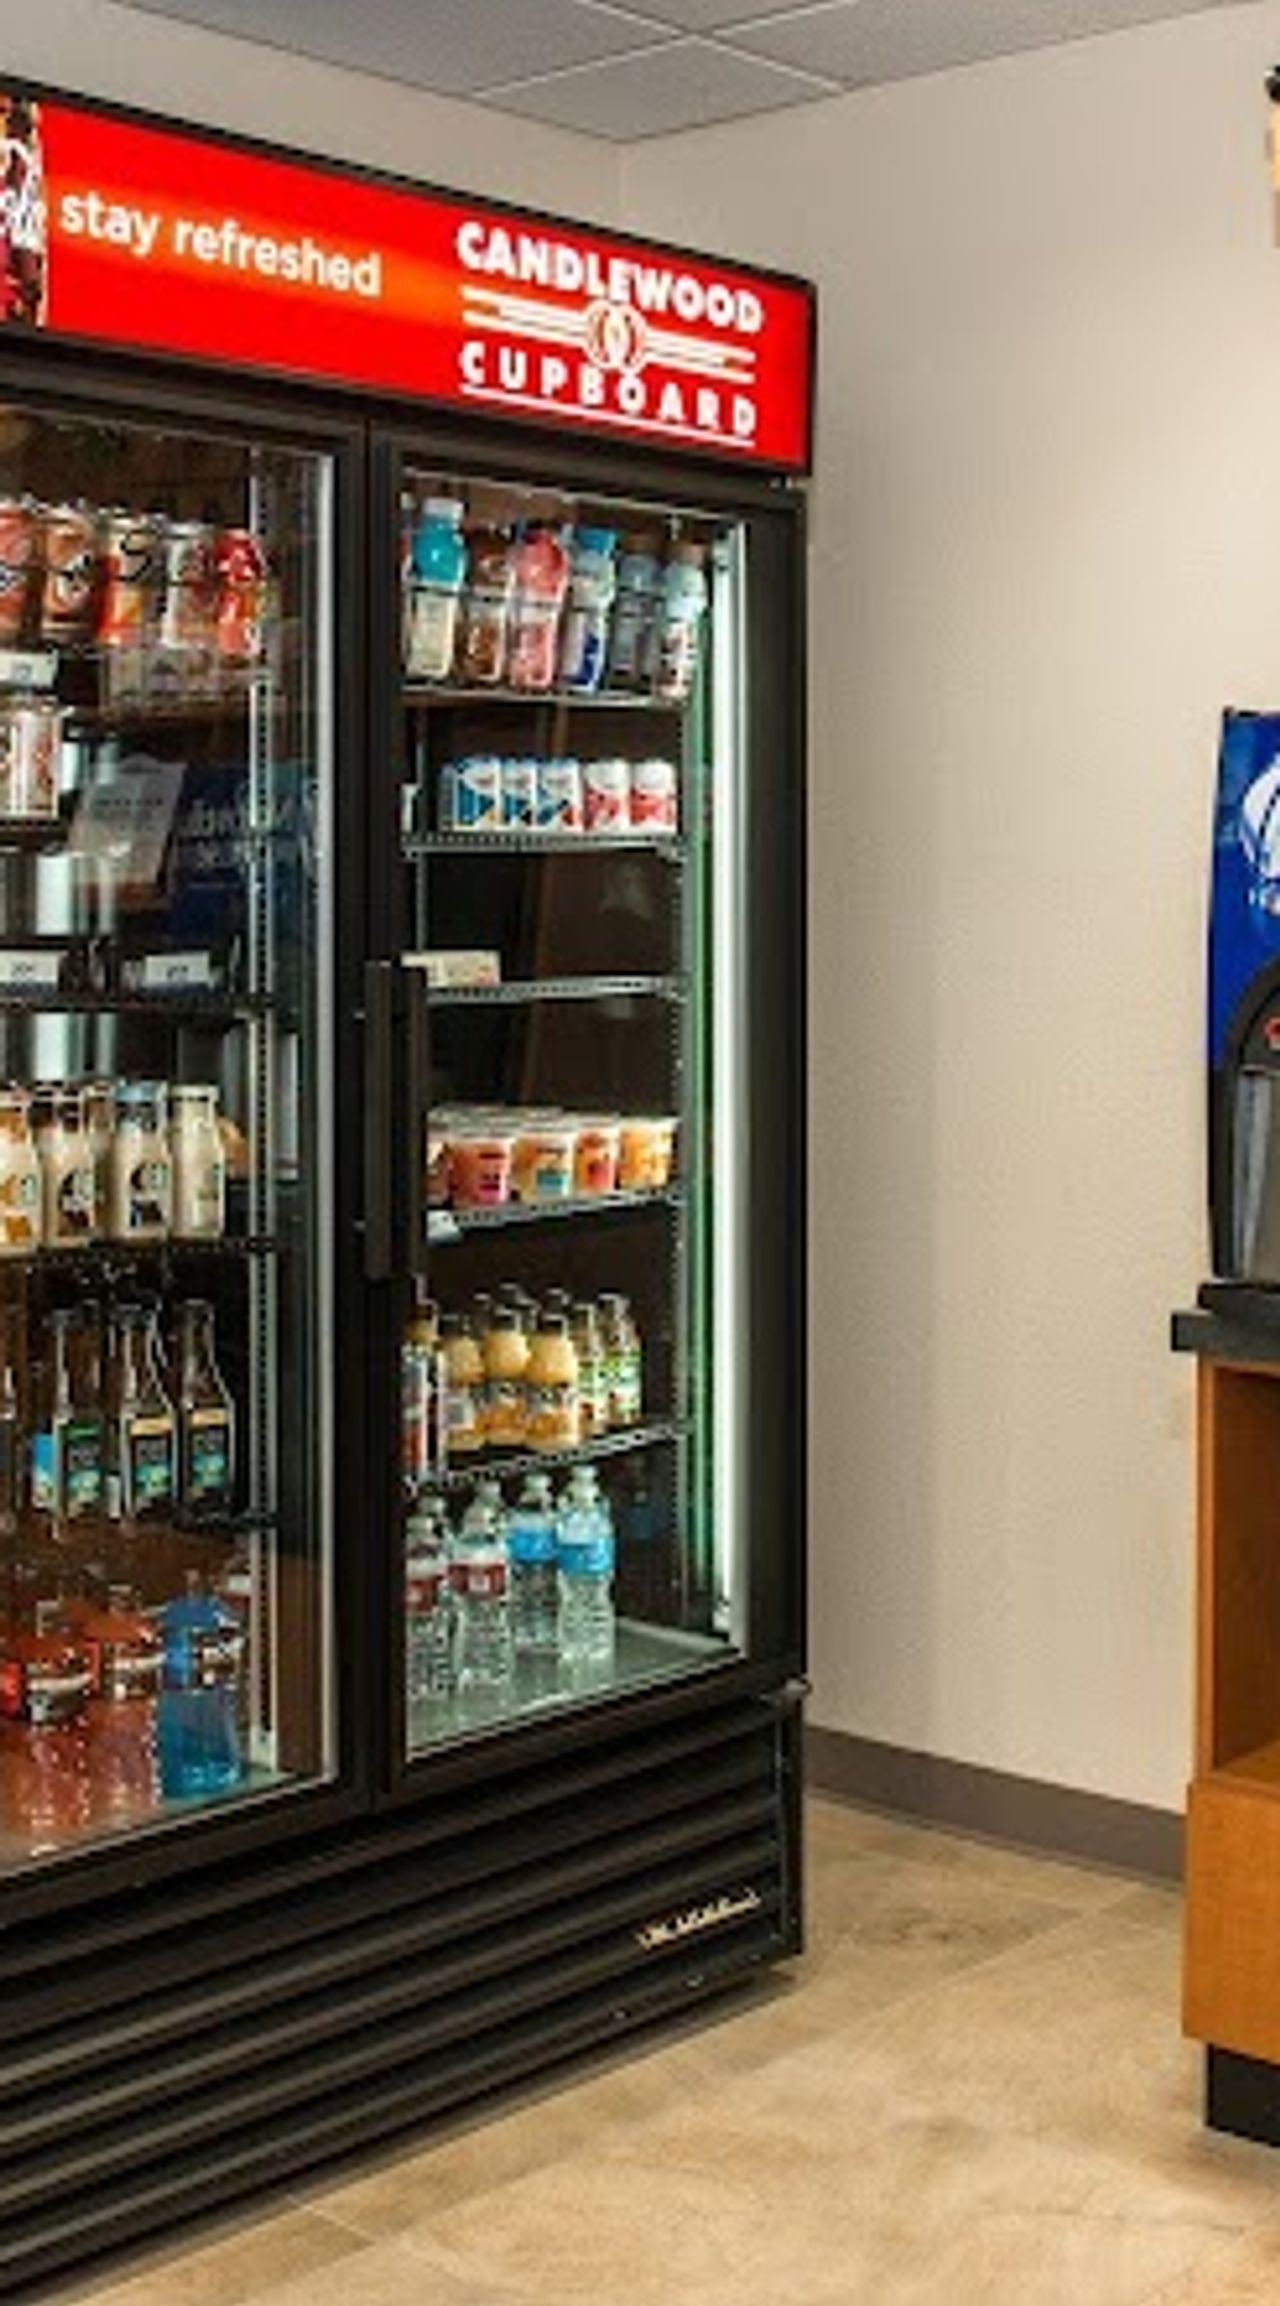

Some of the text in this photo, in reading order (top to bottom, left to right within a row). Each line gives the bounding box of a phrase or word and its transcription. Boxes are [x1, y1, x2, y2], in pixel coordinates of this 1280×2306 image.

[60, 191, 160, 255] stay
[174, 219, 382, 297] refreshed
[455, 221, 764, 333] CANDLEWOOD
[459, 341, 756, 437] CUPBOARD
